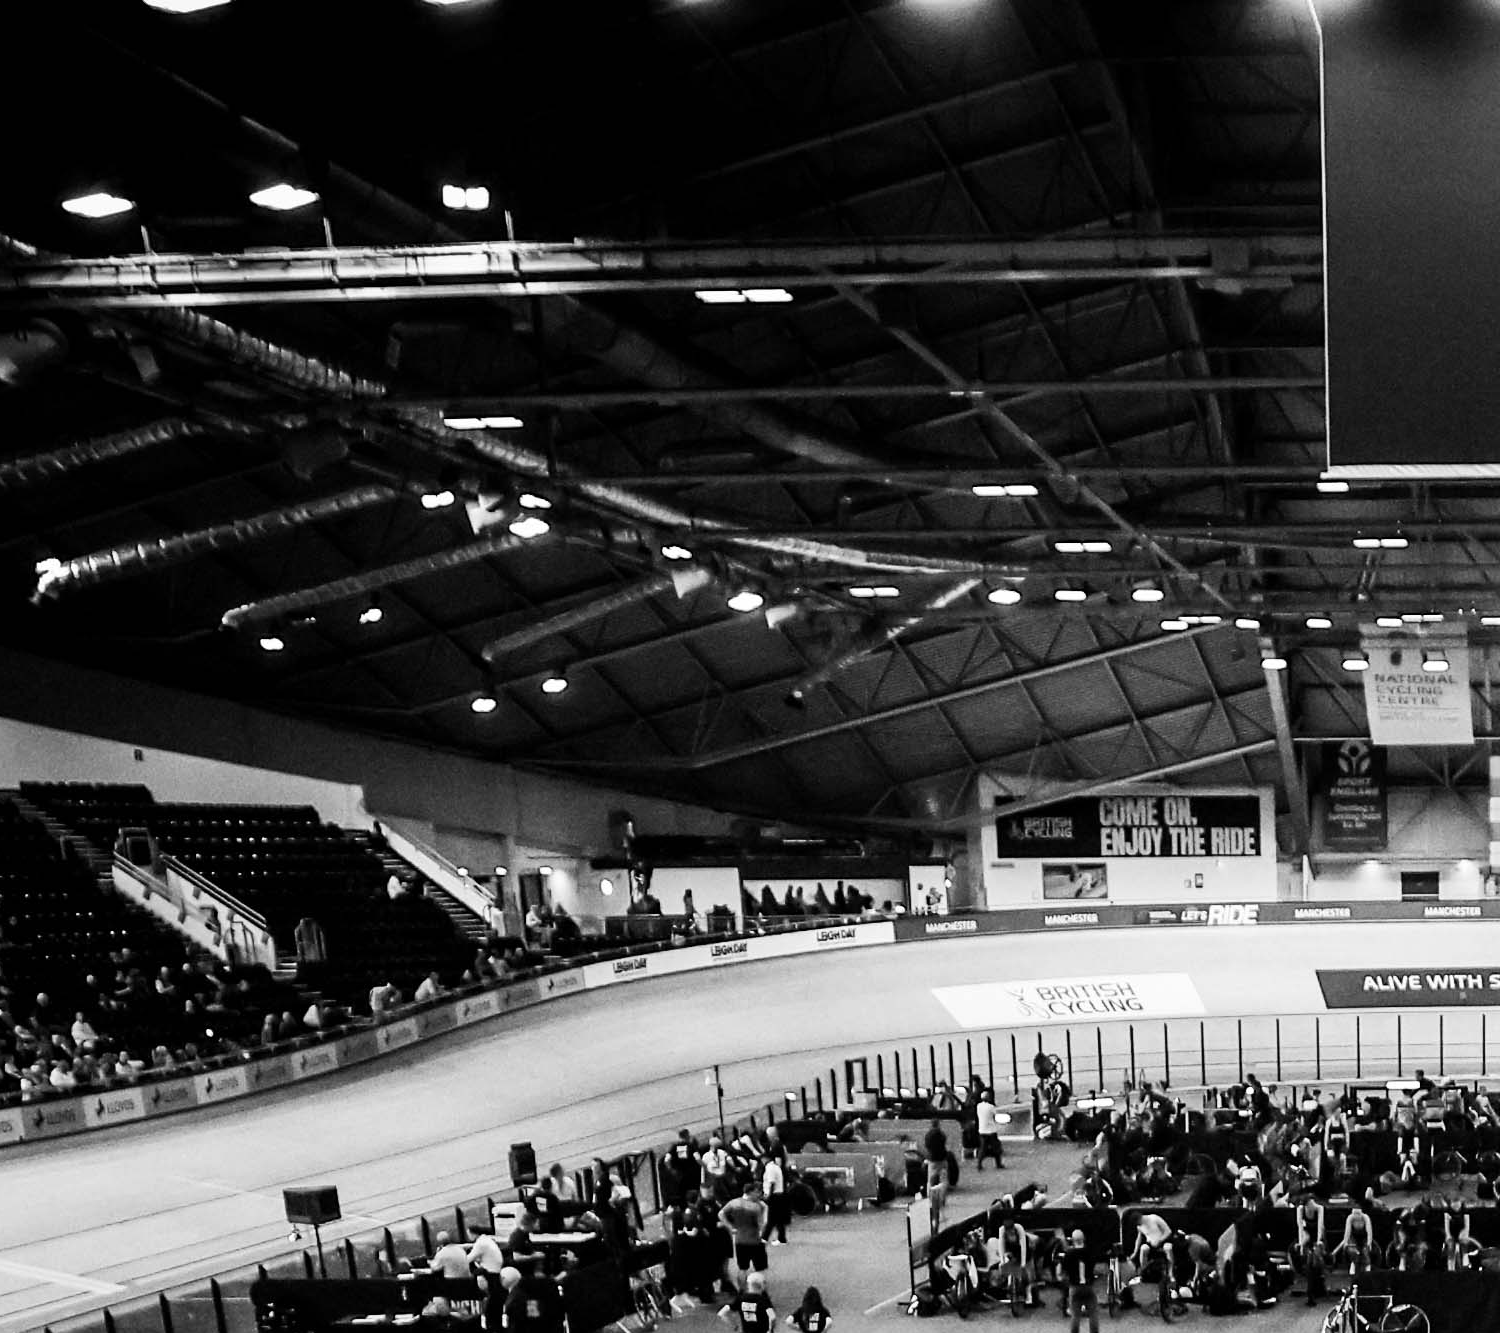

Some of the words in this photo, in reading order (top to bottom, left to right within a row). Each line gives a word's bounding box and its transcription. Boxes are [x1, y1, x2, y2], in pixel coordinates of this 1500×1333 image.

[1374, 673, 1458, 685] NATIONAL
[1375, 686, 1444, 696] CYCLING
[1377, 696, 1439, 706] CENTRE
[1099, 797, 1158, 827] COME
[1023, 816, 1072, 828] BRITISH
[1024, 827, 1073, 839] CYCLING
[1100, 827, 1162, 856] ENJOY
[1169, 827, 1206, 855] THE
[1211, 827, 1256, 855] RIDE
[1180, 910, 1208, 922] LET'S
[1206, 904, 1260, 925] RIDE
[1294, 907, 1351, 919] MANCHESTER
[1423, 905, 1481, 918] MANCHESTER
[1044, 912, 1099, 926] MANCHESTER
[925, 920, 978, 934] MANCHESTER
[1362, 974, 1422, 992] ALIVE
[1426, 973, 1483, 991] WITH
[1036, 982, 1136, 1002] BRITISH
[1047, 997, 1144, 1016] CYCLING
